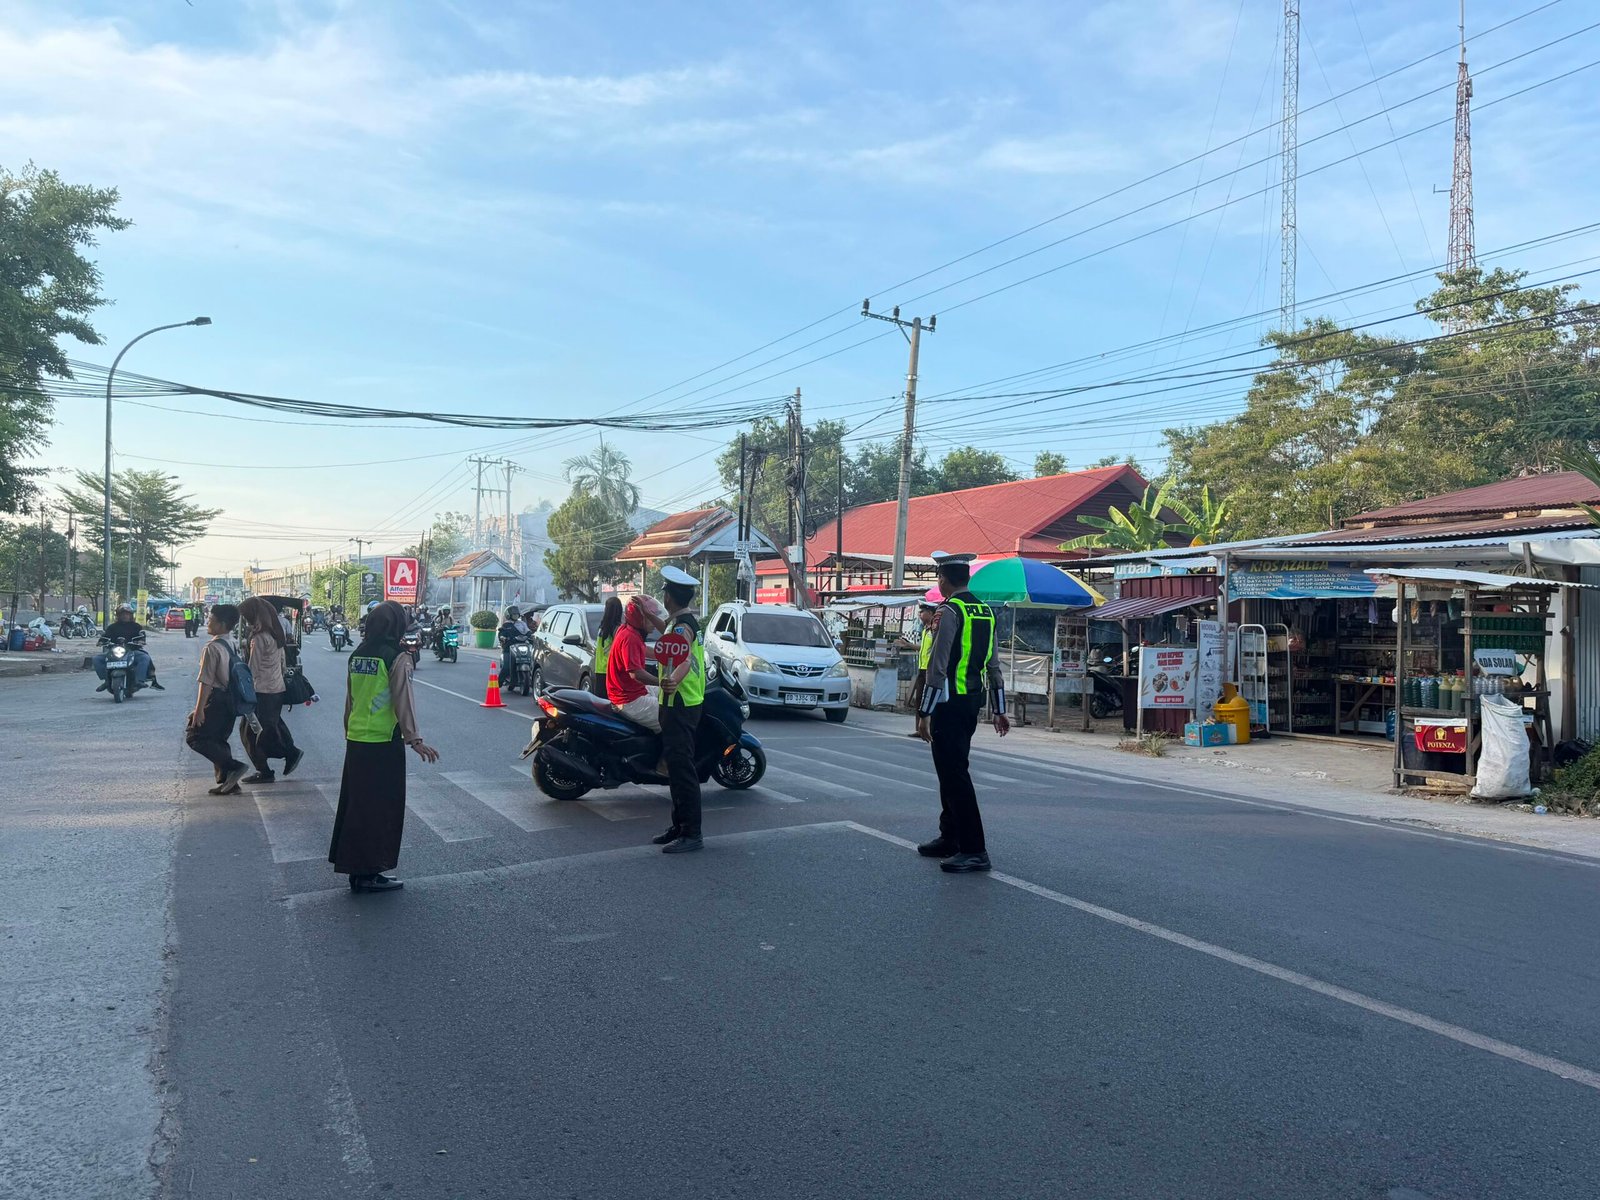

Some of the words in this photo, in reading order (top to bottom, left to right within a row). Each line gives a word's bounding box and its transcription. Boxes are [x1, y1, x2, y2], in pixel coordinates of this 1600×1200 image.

[1116, 562, 1152, 575] urban
[1281, 560, 1329, 571] AZALEA
[655, 641, 689, 656] STOP
[1479, 657, 1493, 668] ADA
[1493, 657, 1514, 668] SOLAR
[1427, 741, 1455, 749] POTENZA
